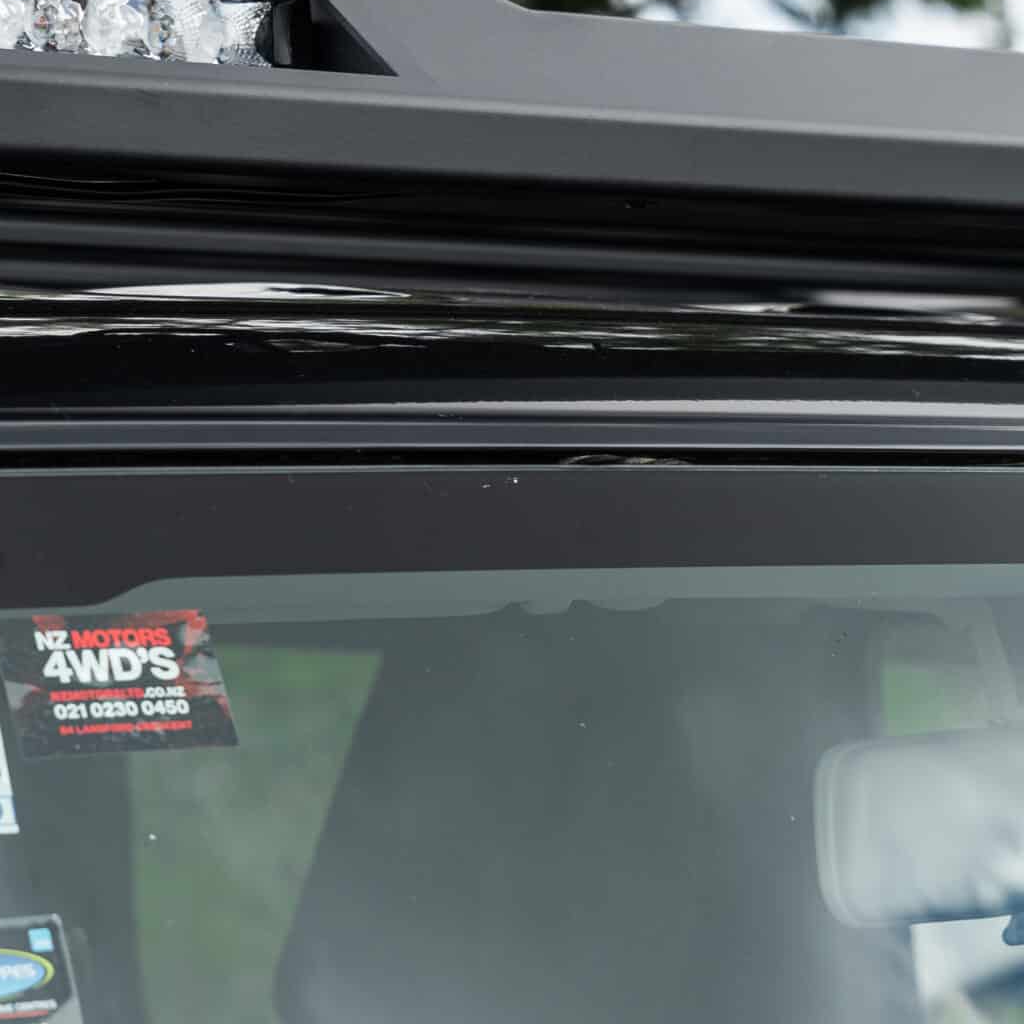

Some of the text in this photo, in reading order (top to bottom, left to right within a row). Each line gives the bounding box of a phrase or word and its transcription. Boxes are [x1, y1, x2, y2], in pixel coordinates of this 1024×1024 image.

[34, 628, 173, 651] NZ MOTORS
[42, 646, 181, 683] 4WD'S
[53, 699, 190, 720] 021 0230 0450
